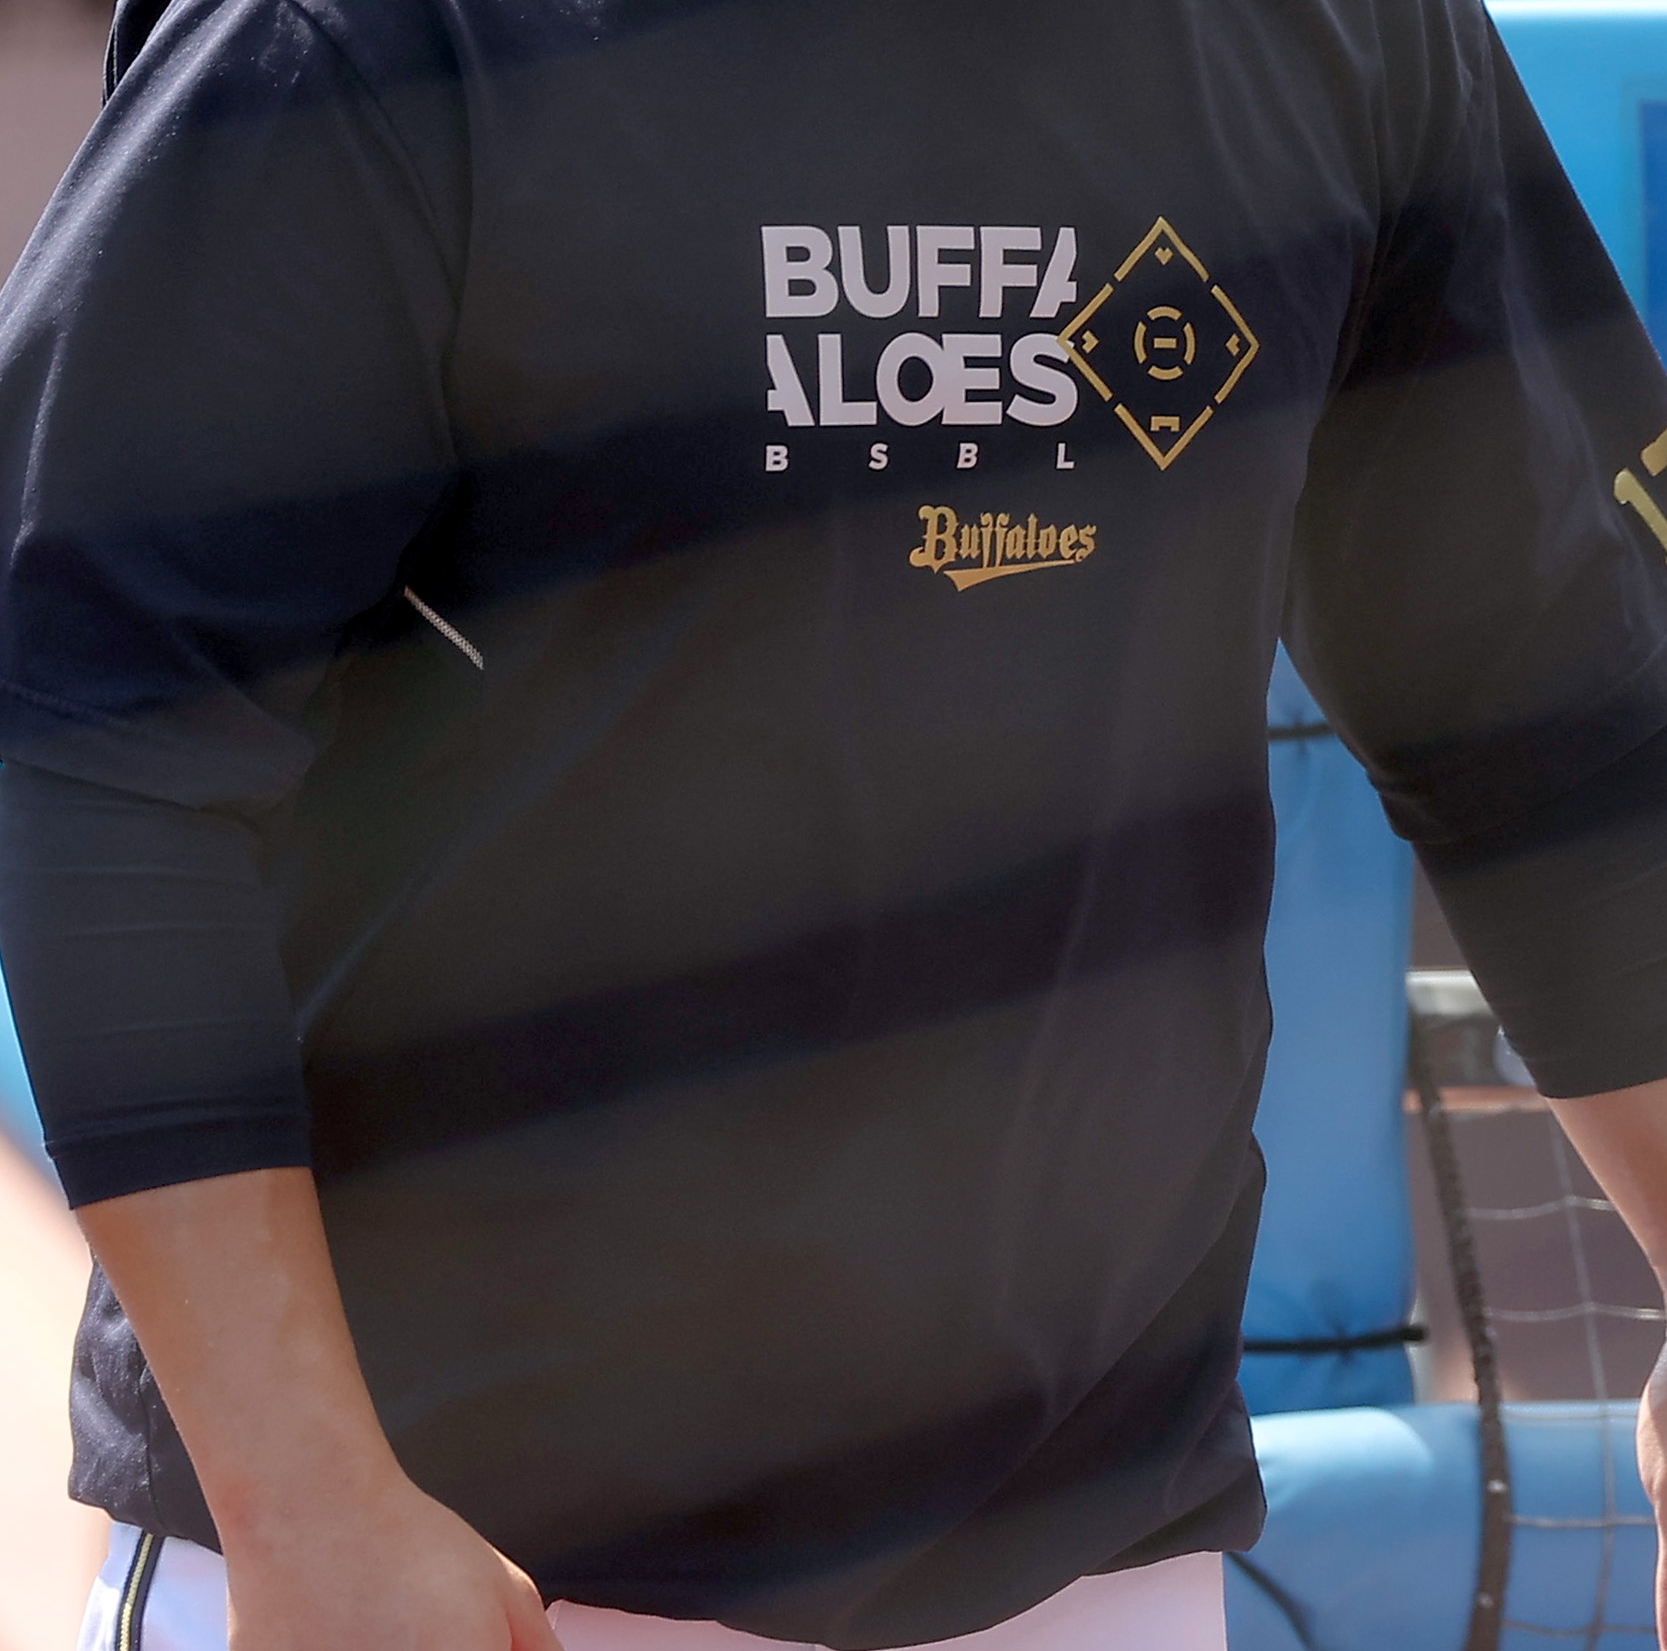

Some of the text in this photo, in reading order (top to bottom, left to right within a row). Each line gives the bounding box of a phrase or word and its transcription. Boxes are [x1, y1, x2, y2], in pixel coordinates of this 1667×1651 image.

[761, 225, 1077, 318] BUFFA
[766, 332, 1079, 426] ALOES
[909, 505, 1097, 584] Buffaloes
